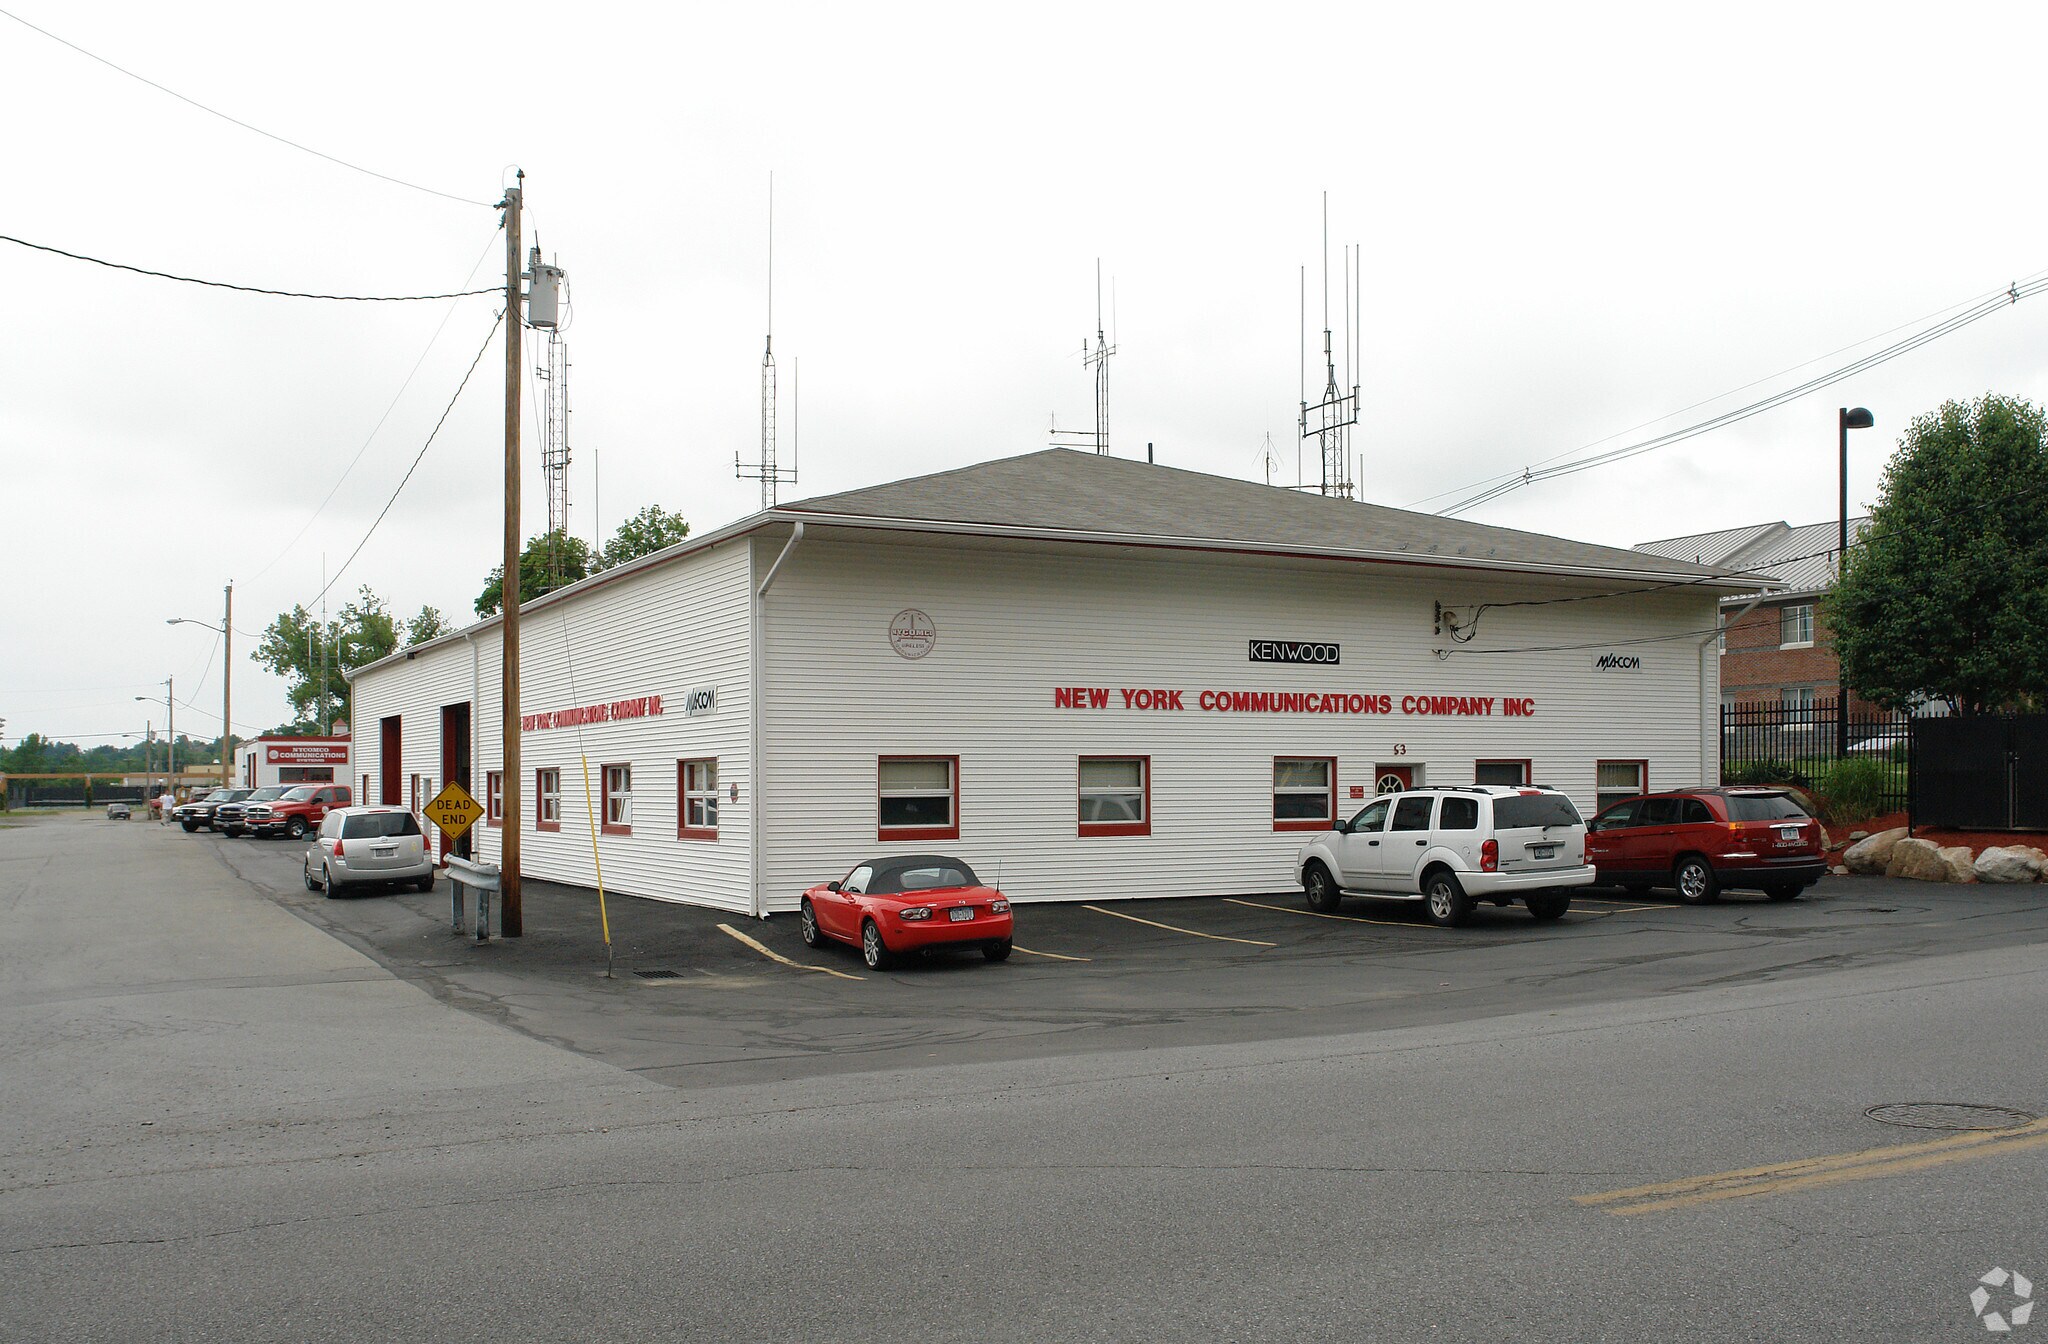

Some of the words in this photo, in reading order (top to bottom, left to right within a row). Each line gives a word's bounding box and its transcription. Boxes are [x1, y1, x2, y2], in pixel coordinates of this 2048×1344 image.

[1250, 642, 1338, 662] KENWOOD
[1055, 687, 1110, 709] NEW
[1121, 688, 1184, 711] YORK
[1200, 690, 1392, 714] COMMUNICATIONS
[1401, 695, 1495, 715] COMPANY
[1503, 697, 1535, 717] INC
[522, 715, 535, 731] NEW
[536, 712, 553, 729] YORK
[553, 703, 609, 728] COMMUNICATIONS
[611, 697, 648, 721] COMPANY
[648, 694, 663, 716] INC
[1393, 744, 1406, 755] 53
[436, 800, 471, 810] DEAD
[442, 814, 467, 825] END
